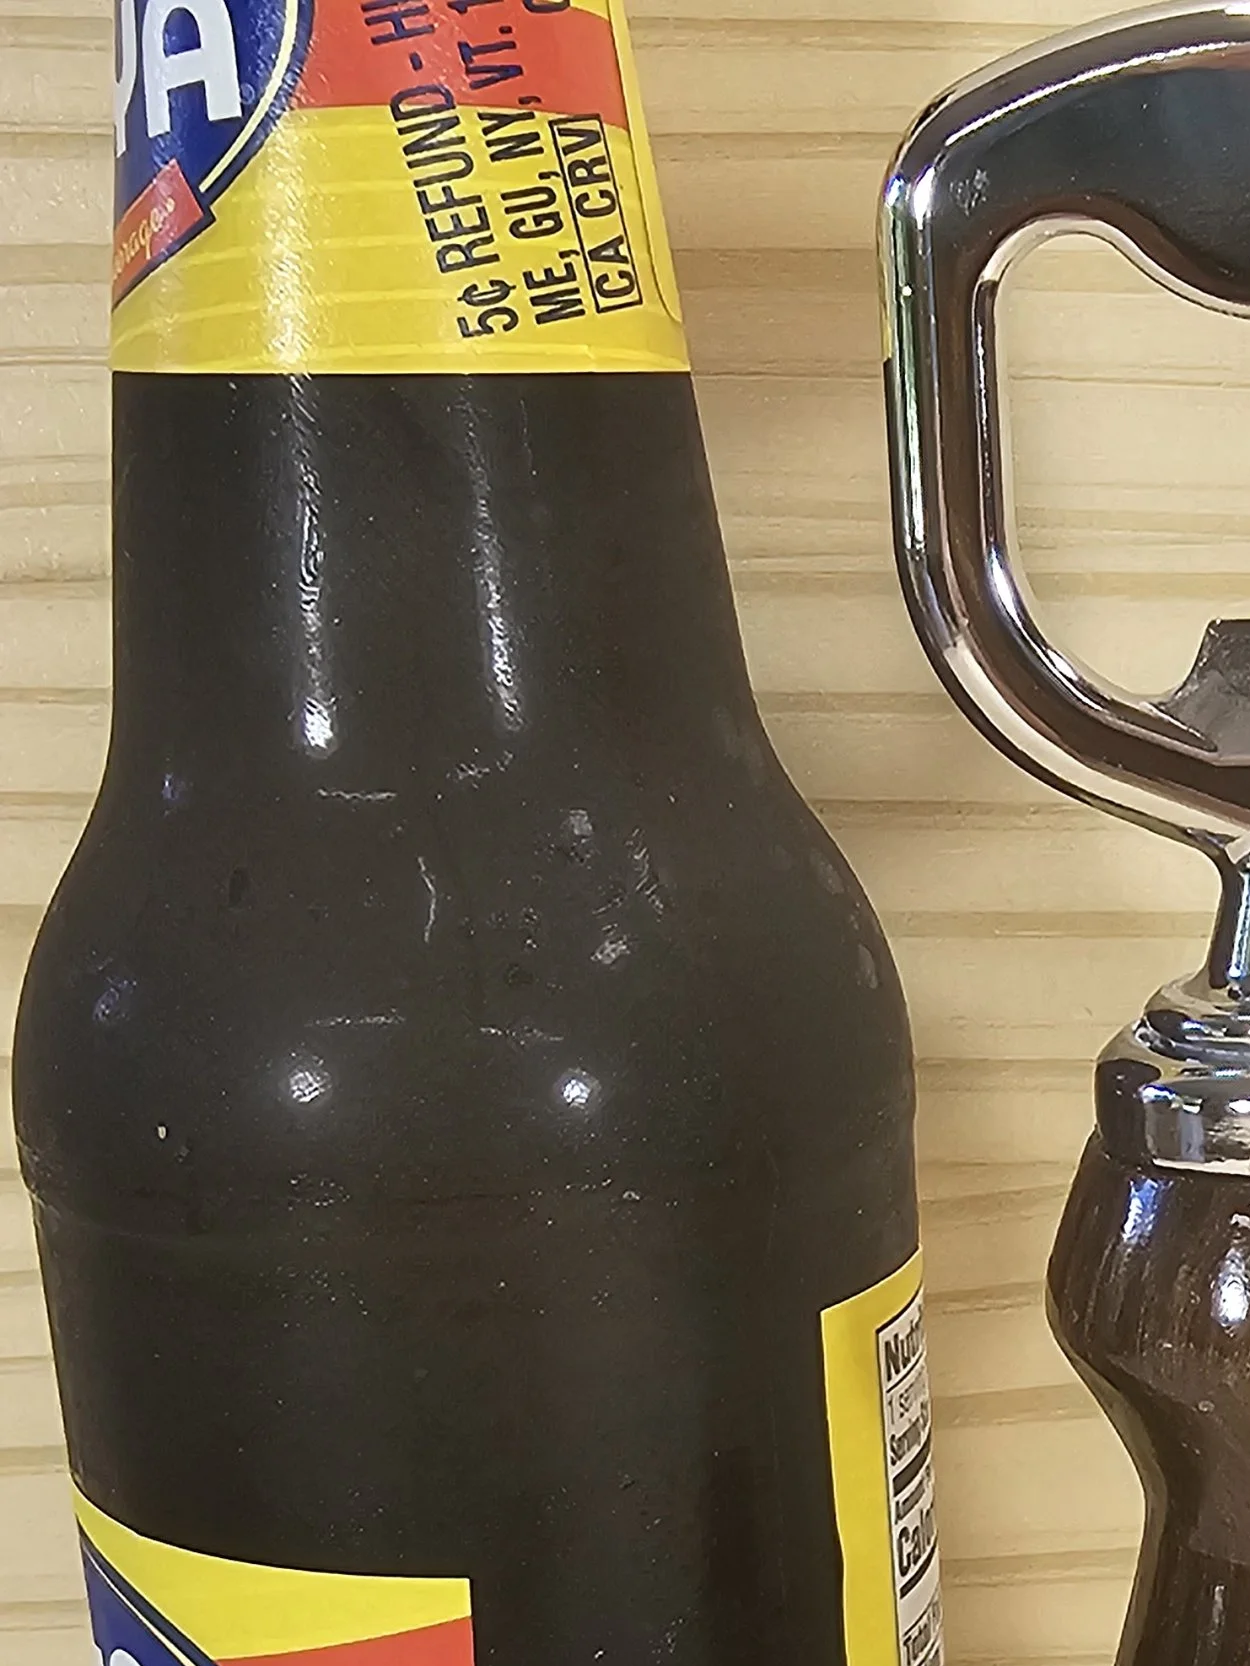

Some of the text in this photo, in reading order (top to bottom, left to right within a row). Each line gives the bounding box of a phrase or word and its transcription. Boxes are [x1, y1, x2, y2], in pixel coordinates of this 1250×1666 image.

[457, 25, 524, 91] VT.
[477, 95, 544, 163] NY,
[390, 83, 501, 274] REFUND
[501, 171, 565, 240] GU,
[557, 127, 636, 300] CA CRV
[456, 279, 519, 338] 5¢
[522, 249, 586, 325] ME,
